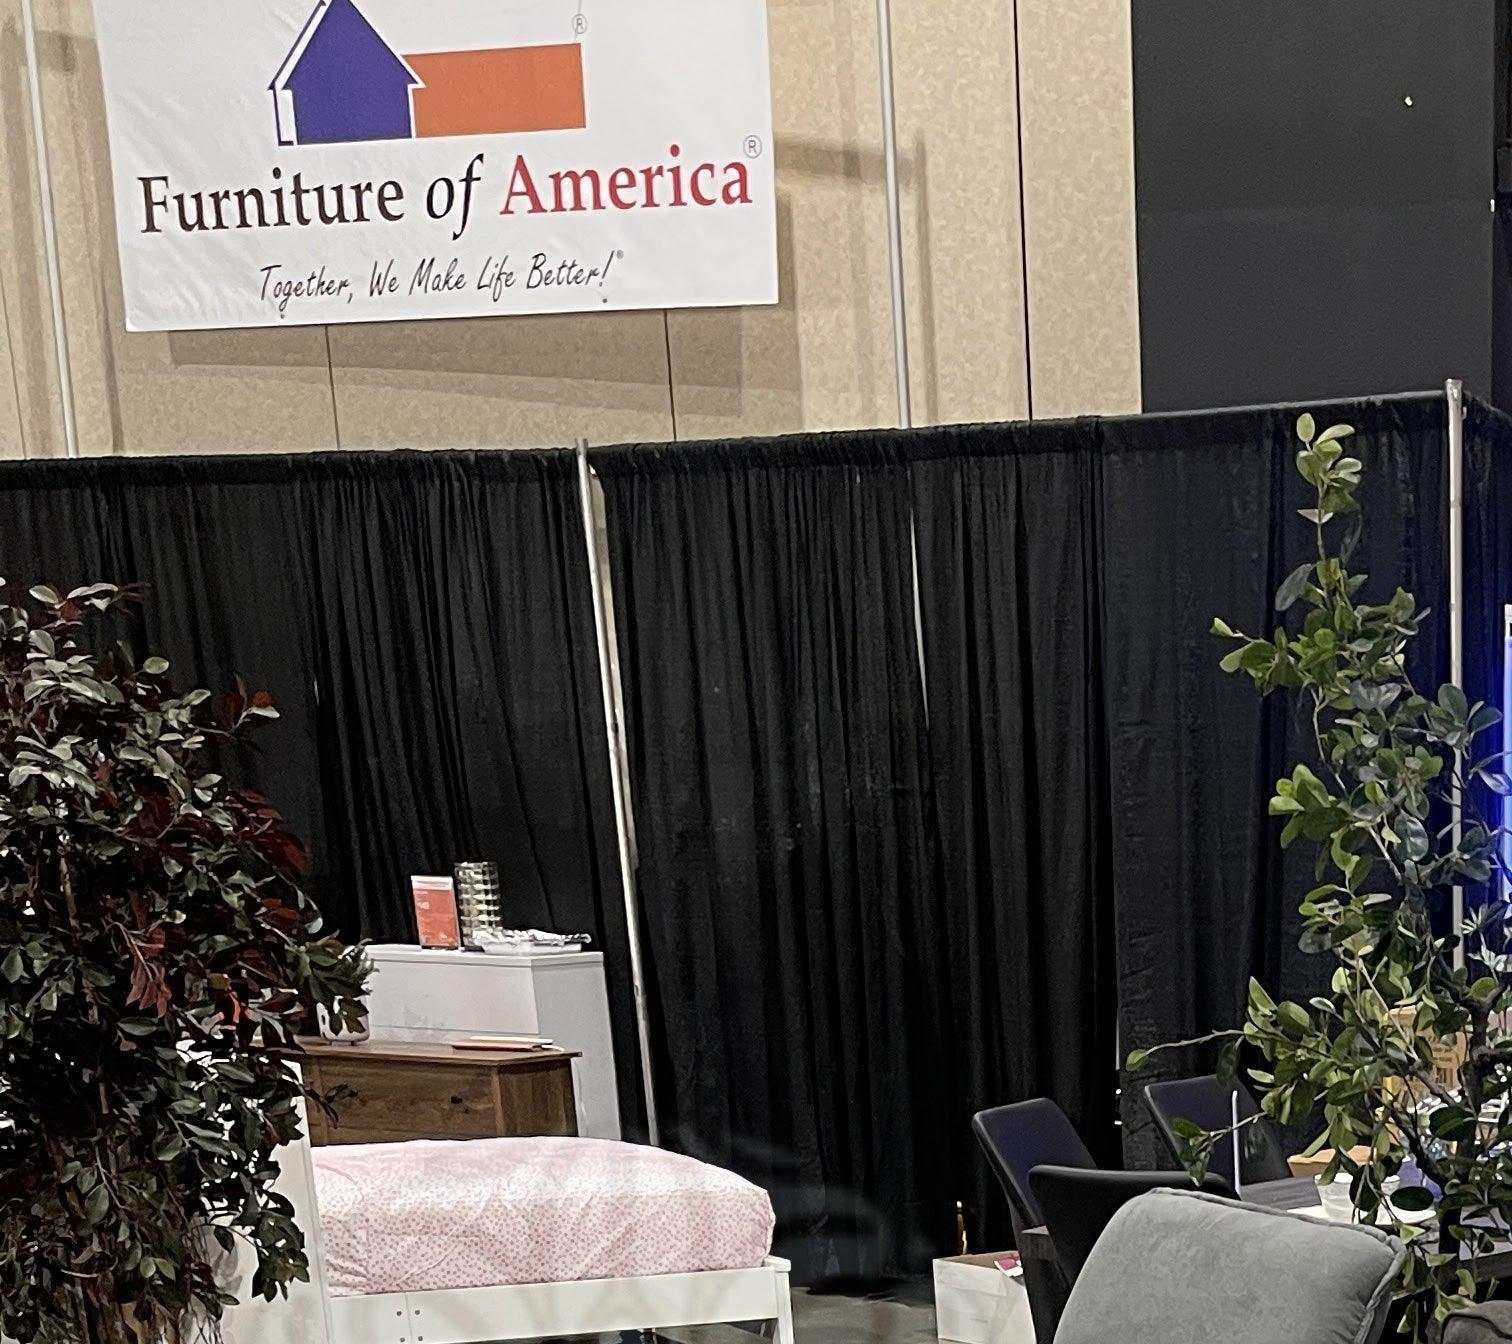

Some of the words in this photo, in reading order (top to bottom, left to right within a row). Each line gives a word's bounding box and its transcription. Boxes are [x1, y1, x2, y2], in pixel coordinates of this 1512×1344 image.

[138, 166, 405, 235] Furniture
[424, 152, 485, 241] of
[258, 263, 354, 312] Together,
[368, 257, 401, 299] We
[407, 256, 467, 298] Make
[475, 253, 517, 303] Life
